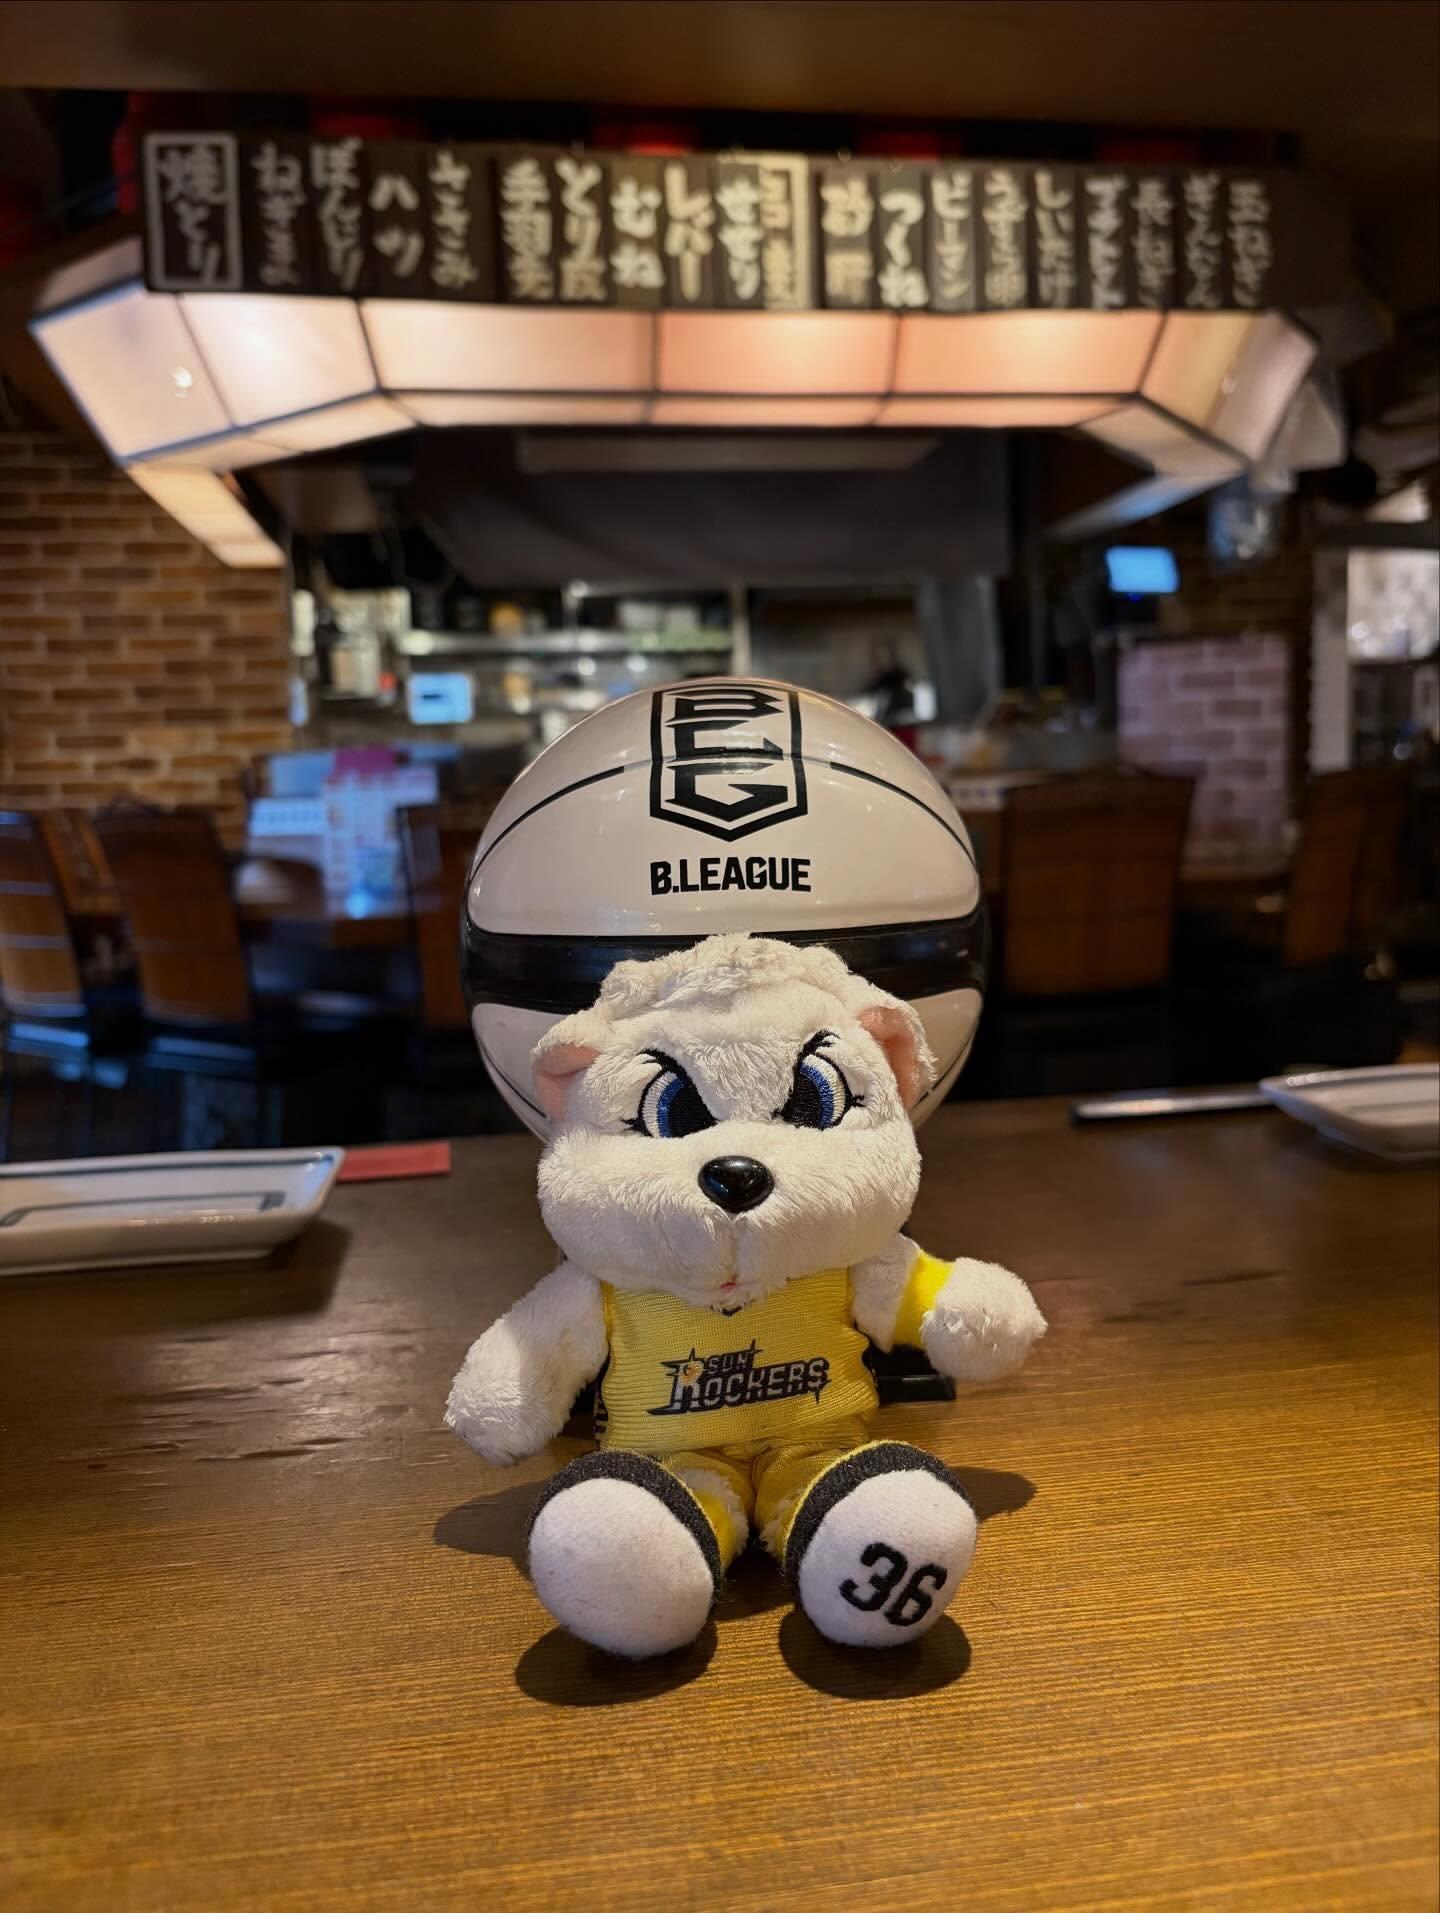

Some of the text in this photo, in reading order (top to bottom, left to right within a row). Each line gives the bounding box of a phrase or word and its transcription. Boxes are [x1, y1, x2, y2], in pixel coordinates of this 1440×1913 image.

[367, 172, 425, 278] ハツ
[609, 176, 666, 288] むね
[663, 160, 715, 301] レバー
[714, 177, 763, 300] せせり
[879, 190, 930, 309] つくね
[931, 169, 973, 301] ピーマン
[650, 856, 812, 895] B.LEAGUE
[649, 1355, 830, 1416] ROCKERS
[838, 1541, 948, 1627] 36
